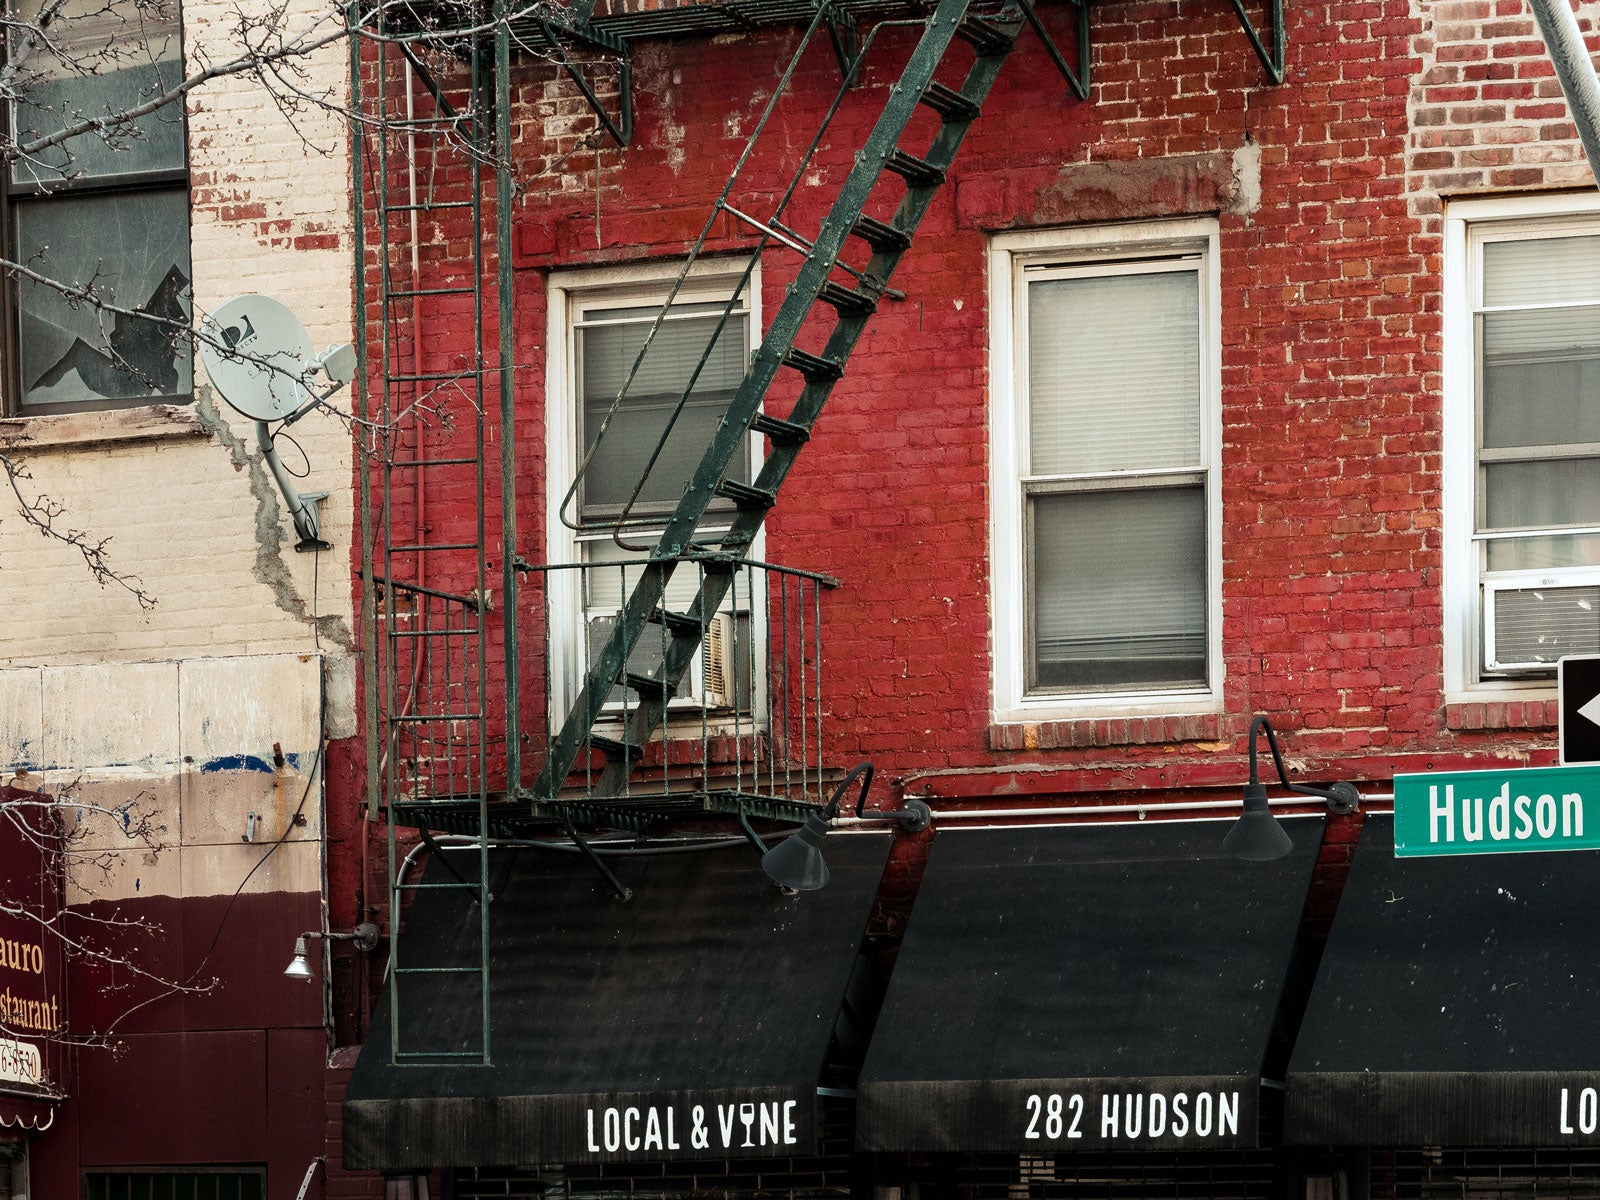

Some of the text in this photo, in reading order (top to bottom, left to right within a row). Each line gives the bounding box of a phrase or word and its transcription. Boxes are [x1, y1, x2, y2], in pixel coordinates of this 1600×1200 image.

[1429, 781, 1584, 843] Hudson
[587, 1106, 680, 1152] LOCAL
[691, 1105, 709, 1149] &
[1025, 1092, 1239, 1139] 282 HUDSON
[1560, 1087, 1598, 1134] LO
